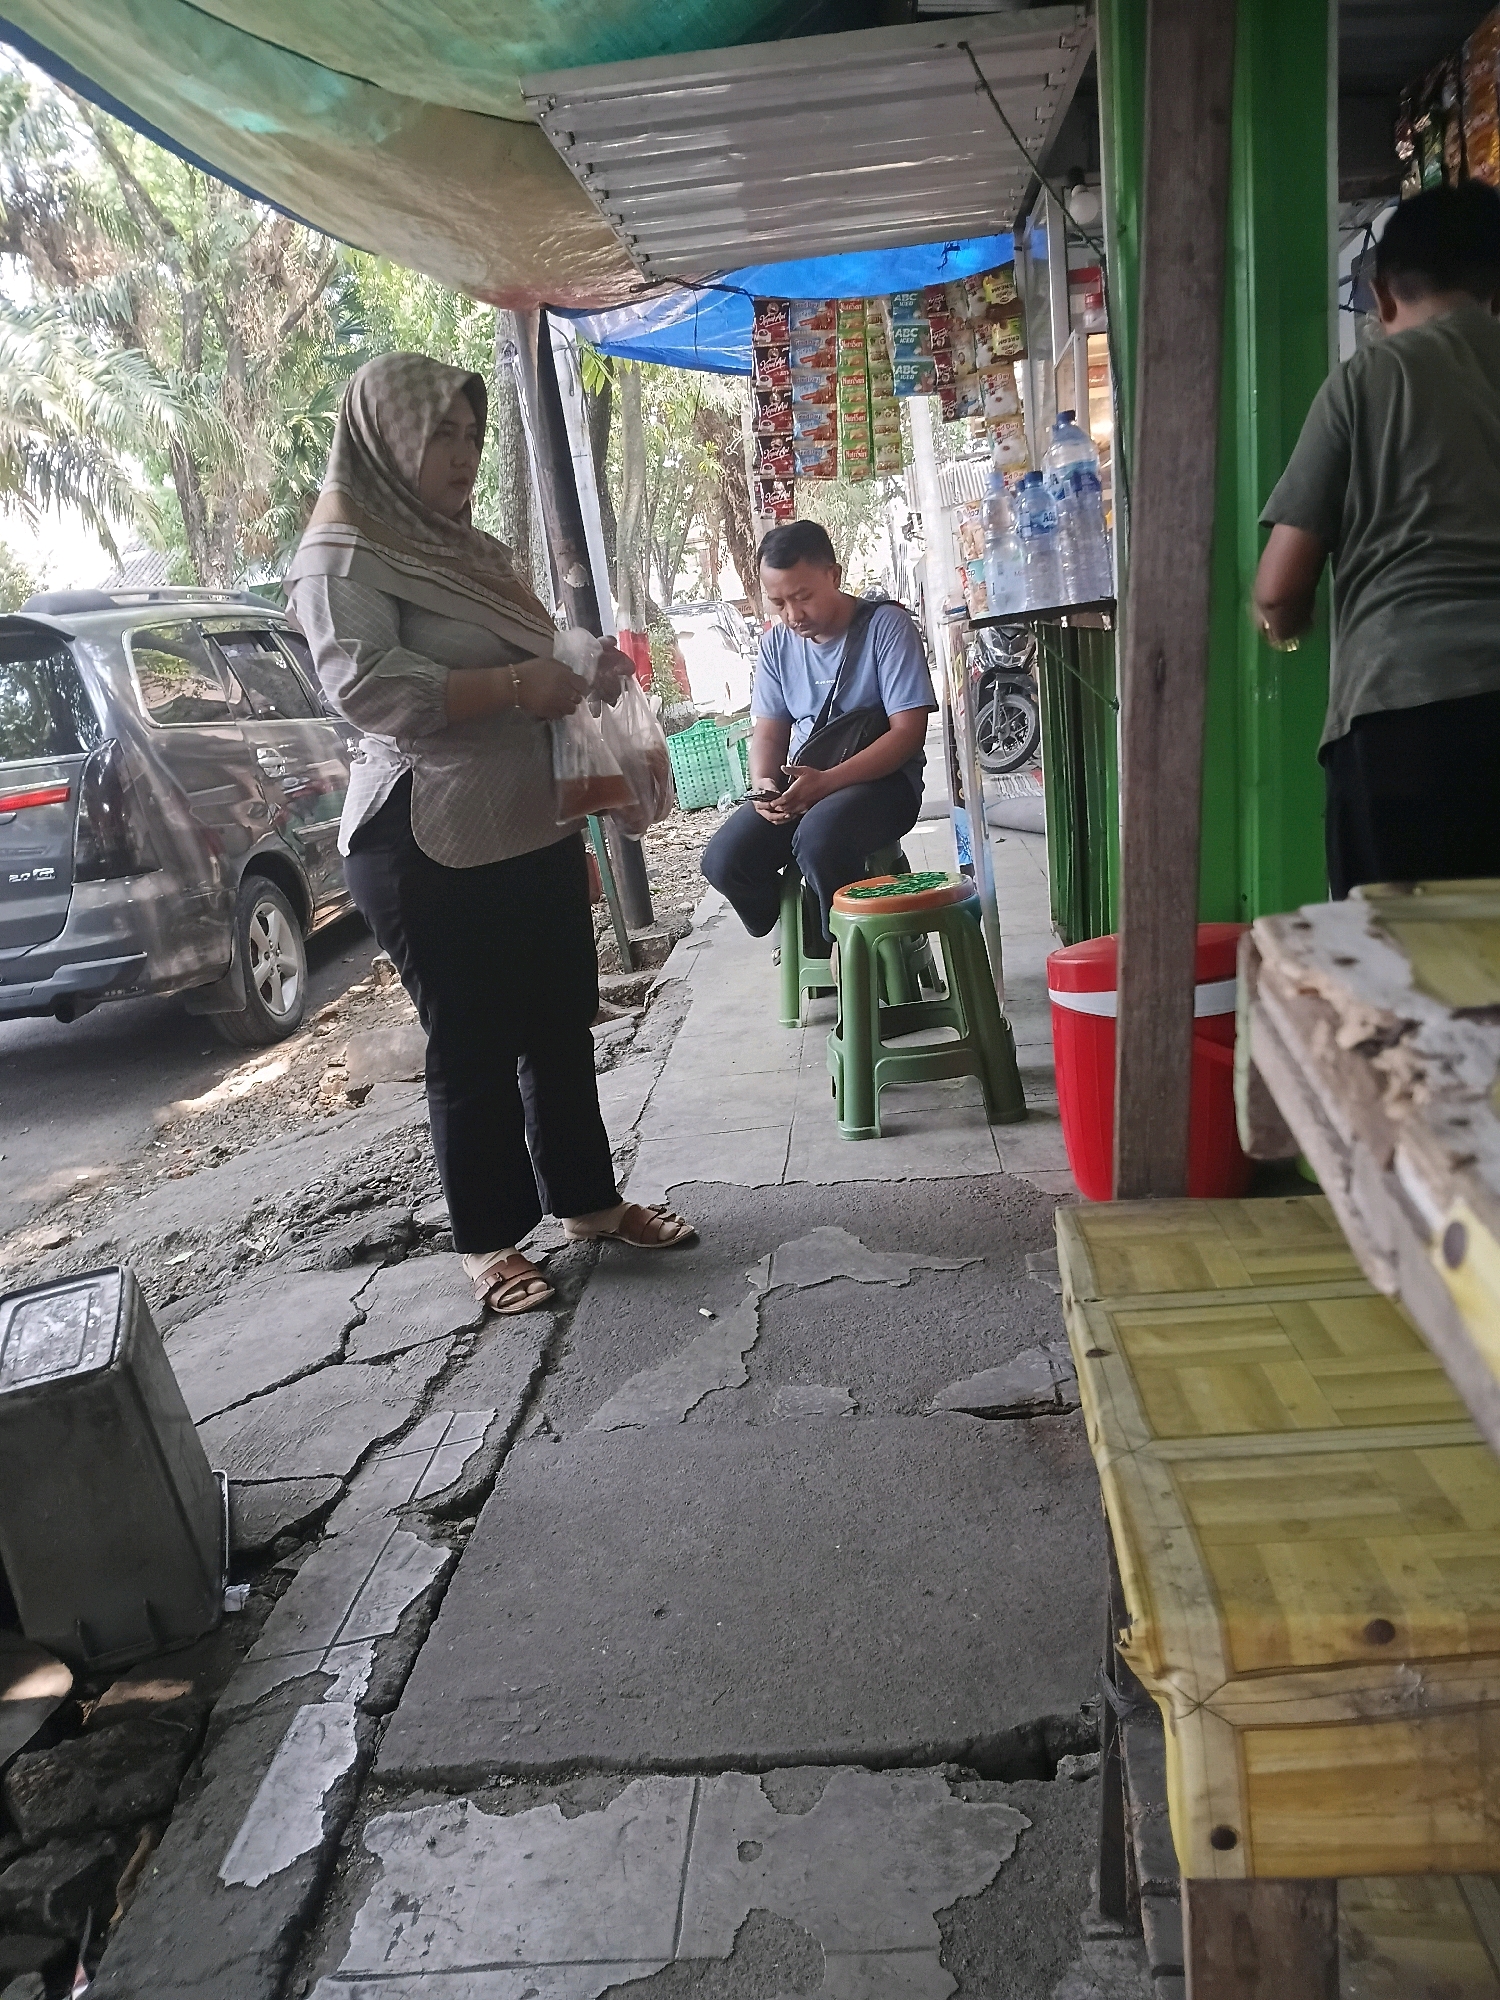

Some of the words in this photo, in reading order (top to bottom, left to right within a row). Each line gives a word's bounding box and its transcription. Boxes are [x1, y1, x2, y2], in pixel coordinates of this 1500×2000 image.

[894, 292, 918, 301] ABC
[894, 328, 918, 337] ABC
[841, 339, 863, 347] NutriSari
[894, 365, 919, 374] ABC
[842, 376, 864, 384] NutriSari
[844, 413, 866, 422] NutriSari
[845, 451, 867, 459] NutriSari
